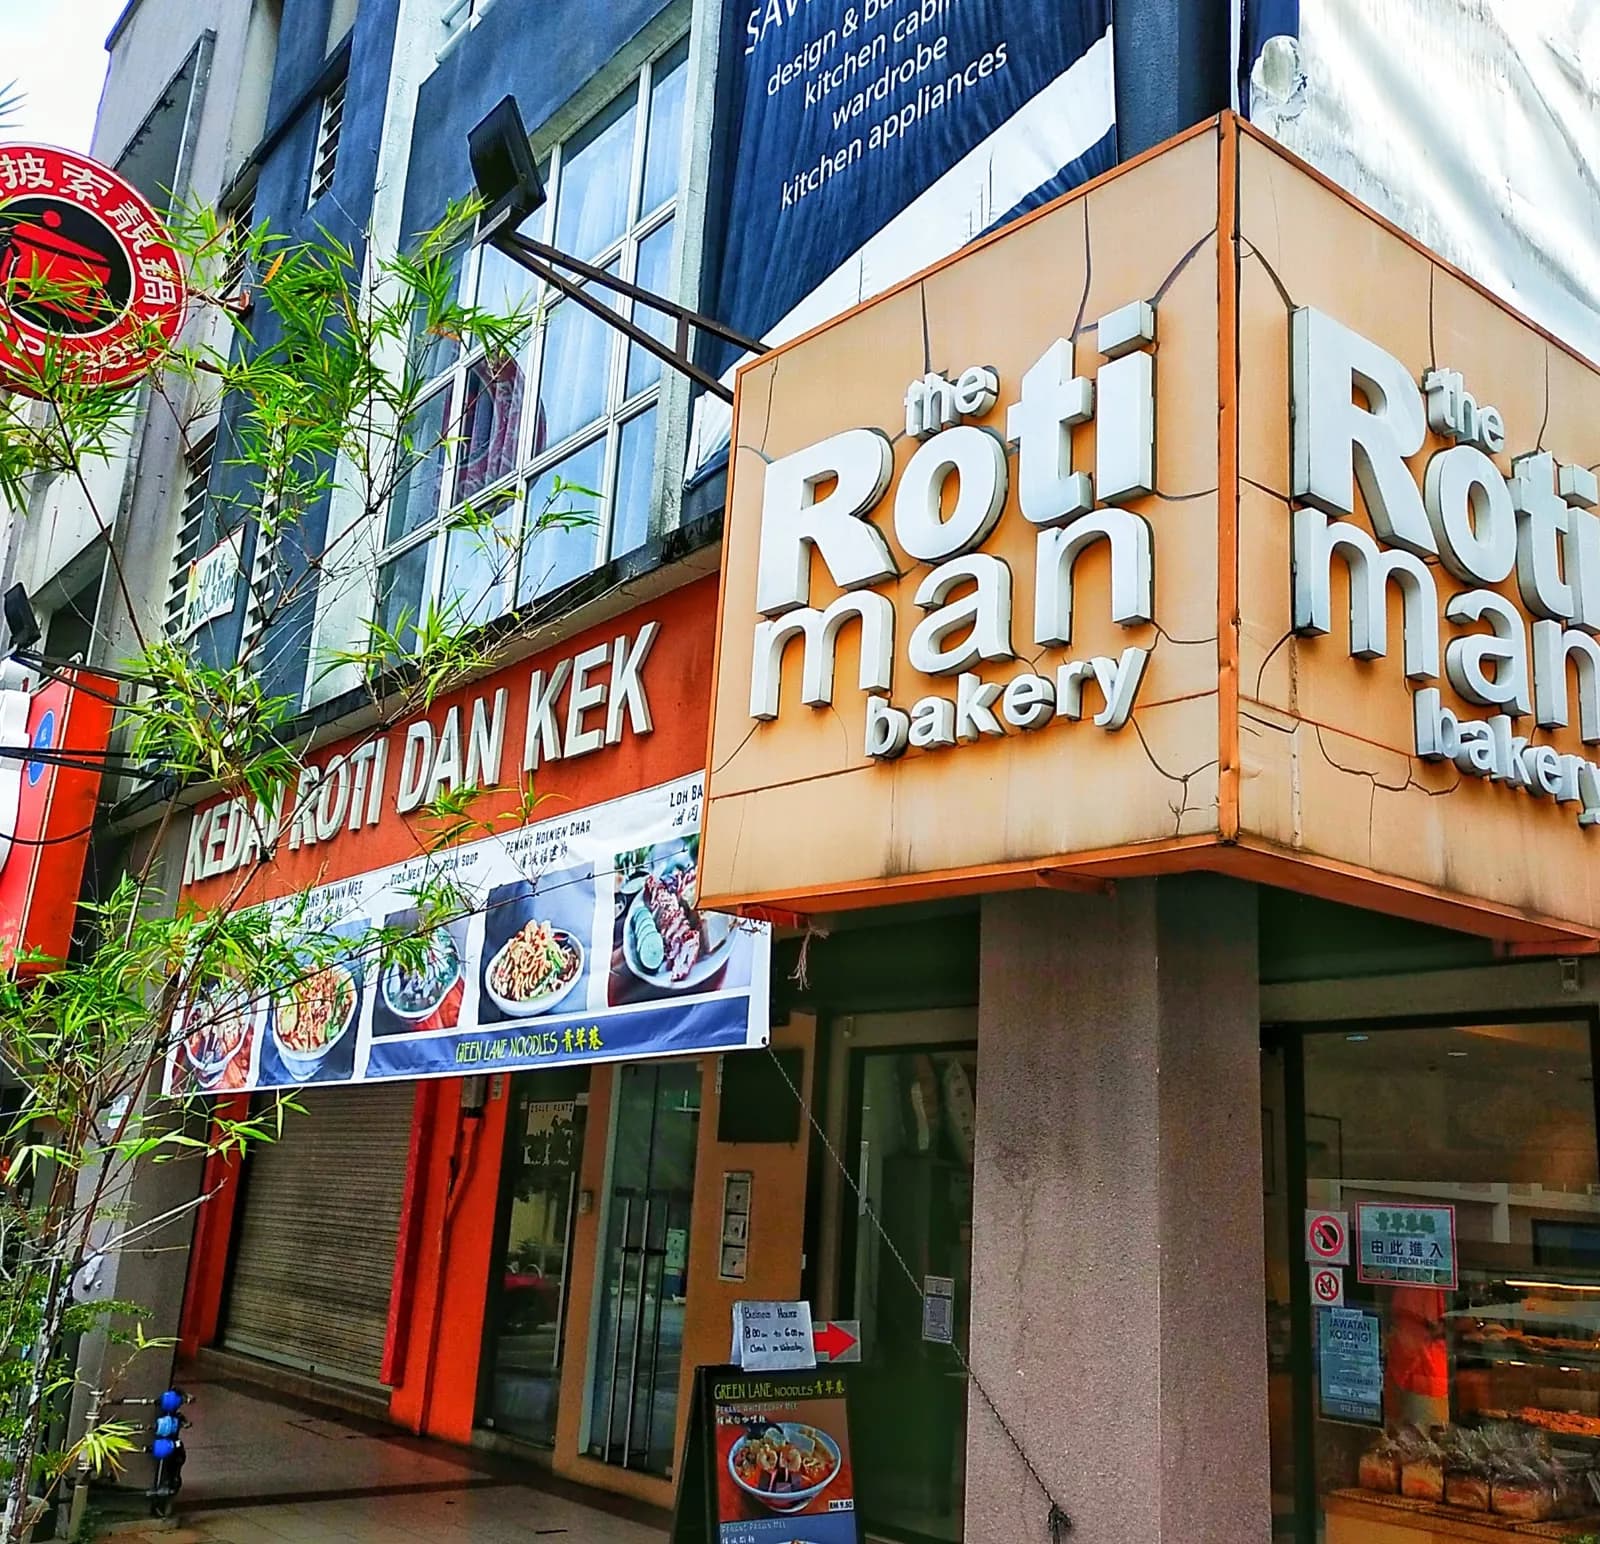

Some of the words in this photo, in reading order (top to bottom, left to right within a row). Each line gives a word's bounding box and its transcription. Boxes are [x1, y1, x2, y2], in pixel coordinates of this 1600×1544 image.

[767, 29, 837, 96] design
[842, 7, 859, 38] &
[804, 34, 886, 110] kitchen
[831, 36, 948, 130] wardrobe
[781, 138, 862, 210] kitchen
[868, 42, 1008, 150] appliances
[904, 365, 999, 440] the
[1422, 366, 1505, 454] the
[756, 300, 1156, 617] Roti
[749, 508, 1153, 721] man
[1293, 506, 1600, 745] man
[864, 646, 1149, 761] bakery
[183, 780, 286, 886] KEDAI
[289, 737, 390, 850] ROTI
[397, 687, 509, 814] DAN
[523, 621, 661, 772] KEK
[570, 820, 591, 836] CHAR
[670, 790, 688, 807] LOH
[692, 784, 703, 800] BA
[348, 880, 364, 897] MEE
[456, 1040, 483, 1064] GREEN
[484, 1038, 508, 1062] LANE
[509, 1031, 558, 1057] NOODLES
[1371, 1240, 1444, 1258] 由此進入
[1376, 1255, 1397, 1264] ENTER
[1399, 1256, 1419, 1265] FROM
[1420, 1258, 1439, 1267] HERE
[1329, 1319, 1371, 1331] JAWATAN
[1329, 1329, 1372, 1345] KOSONG!
[714, 1384, 745, 1400] GREEN
[748, 1382, 773, 1398] LANE
[774, 1385, 813, 1397] NOODLES
